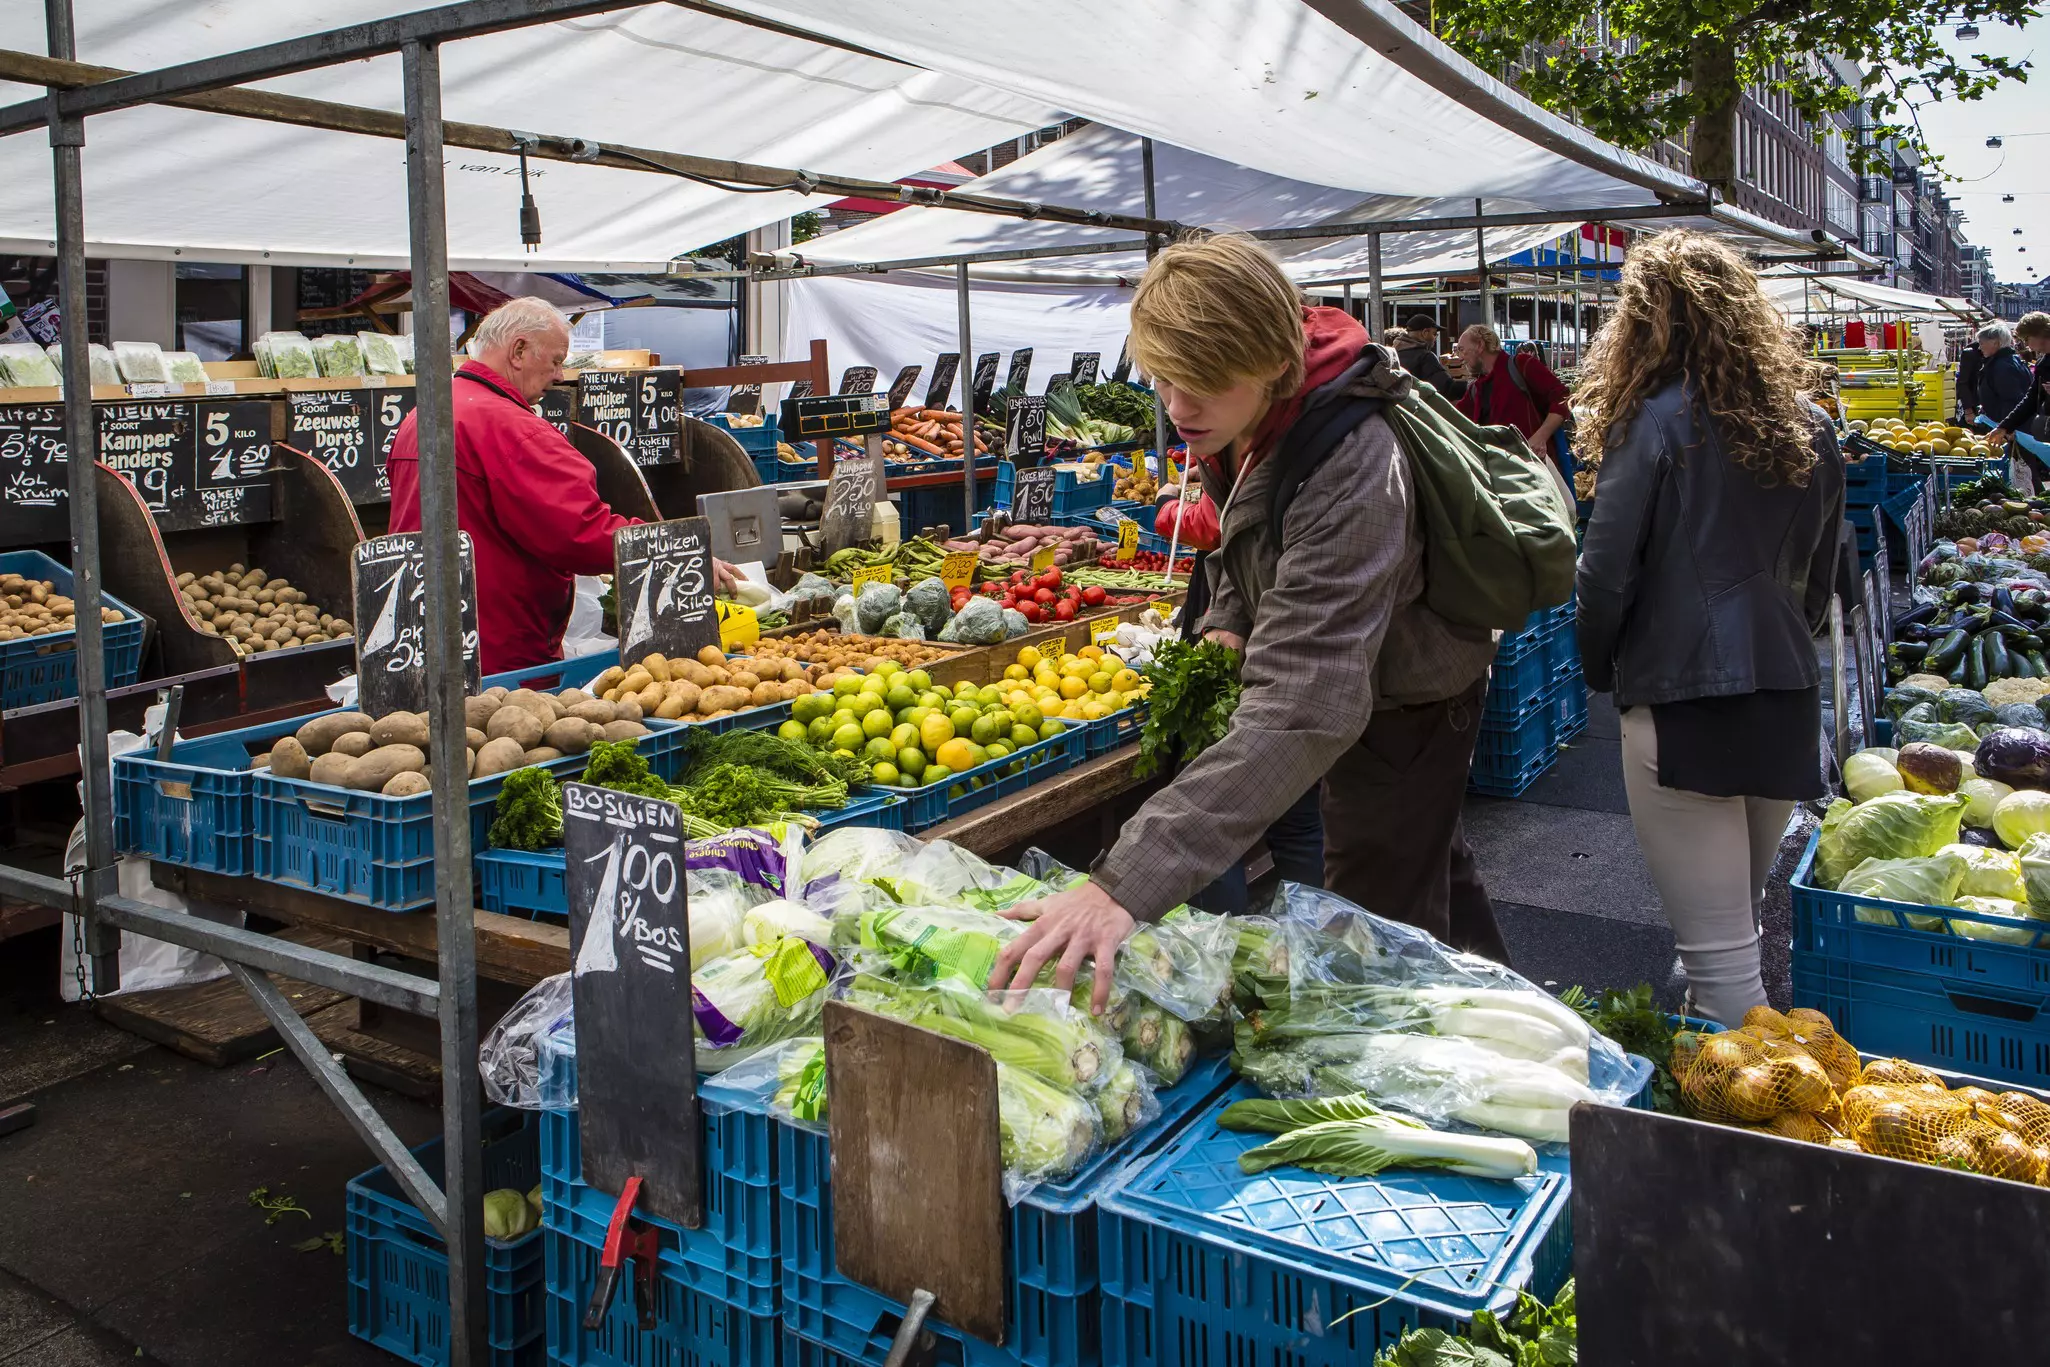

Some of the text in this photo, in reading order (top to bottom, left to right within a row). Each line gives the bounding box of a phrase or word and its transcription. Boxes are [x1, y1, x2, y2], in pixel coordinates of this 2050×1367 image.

[589, 384, 607, 392] SOORT
[641, 376, 674, 404] 5 KILO
[103, 404, 189, 421] NIEUWE
[302, 404, 330, 414] SOORT
[380, 394, 402, 426] 5
[547, 409, 563, 417] KILO
[593, 405, 631, 422] Muizen
[110, 421, 140, 431] SOORT
[206, 412, 256, 446] 5 KILO
[293, 415, 360, 432] Zeeuwse
[101, 431, 180, 452] Kamper-
[101, 450, 174, 469] landers
[11, 470, 48, 487] VOL
[618, 526, 669, 545] NIEUWE
[647, 534, 700, 556] Muizen
[677, 594, 713, 612] KiLO
[690, 848, 727, 858] Chinese
